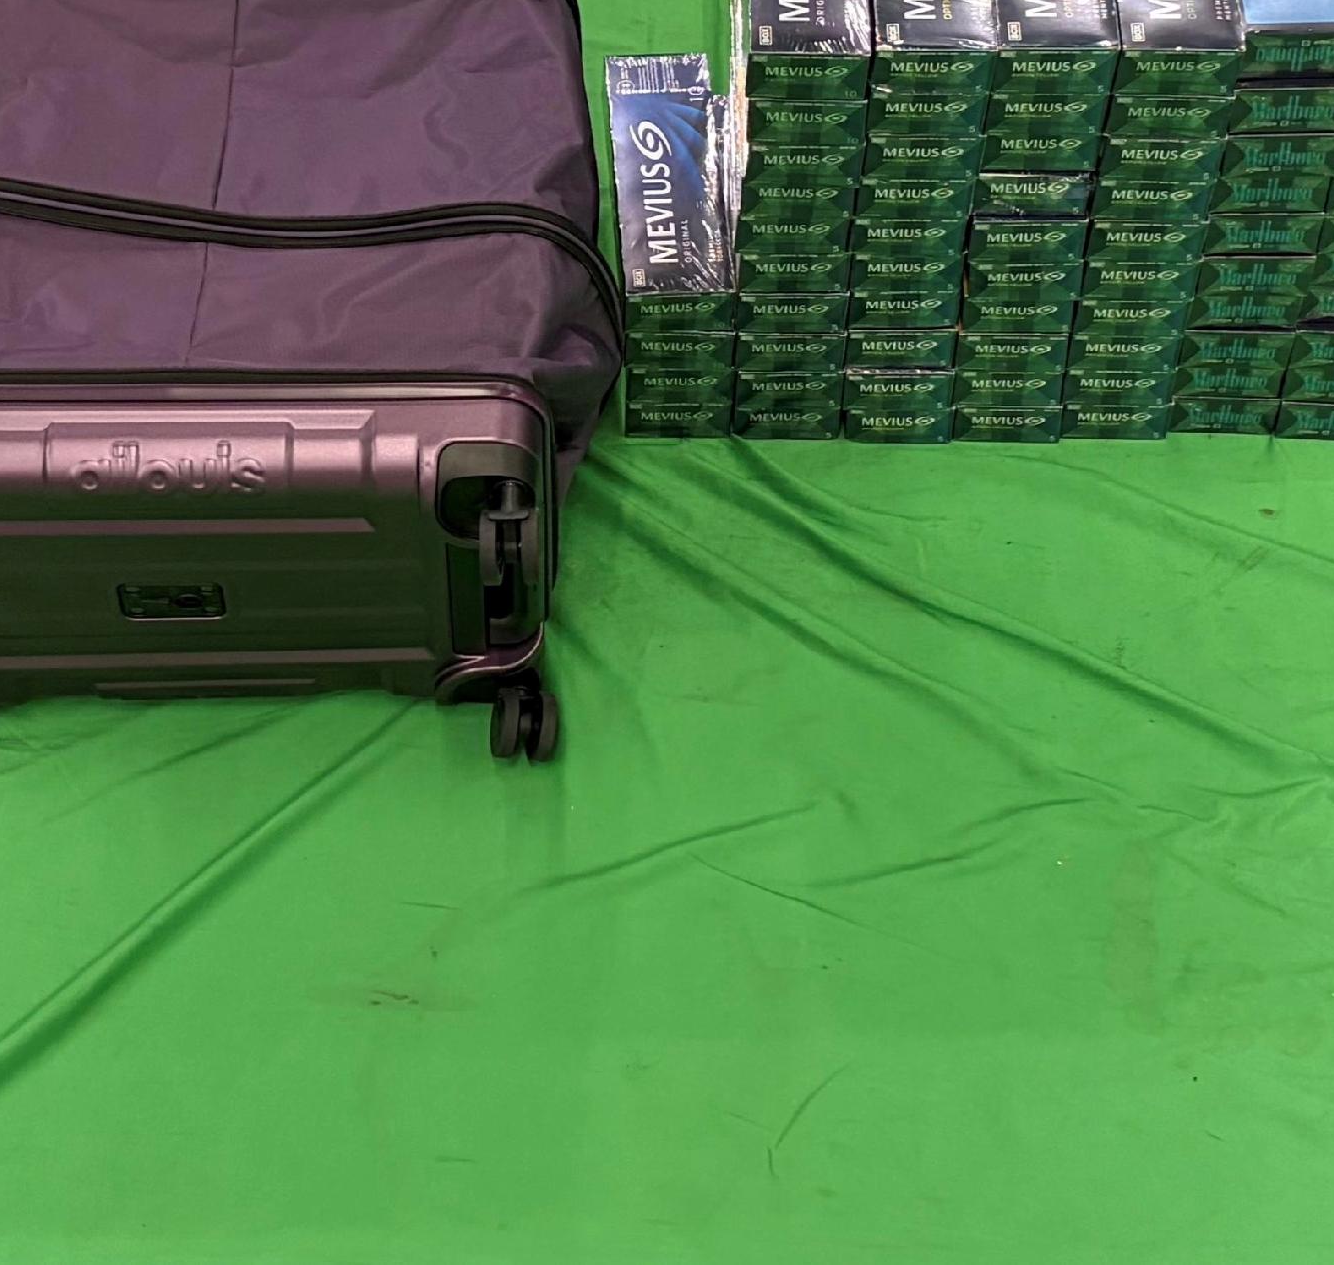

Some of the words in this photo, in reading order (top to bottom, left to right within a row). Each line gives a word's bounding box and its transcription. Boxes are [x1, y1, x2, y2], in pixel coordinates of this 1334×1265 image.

[765, 66, 824, 77] MEVIUS
[891, 62, 949, 73] MEVIUS
[1013, 61, 1073, 72] MEVIUS
[1137, 61, 1195, 72] MEVIUS
[885, 102, 944, 113] MEVIUS
[1005, 102, 1063, 113] MEVIUS
[1128, 107, 1187, 118] MEVIUS
[765, 113, 823, 124] MEVIUS
[1000, 139, 1058, 149] MEVIUS
[883, 147, 939, 158] MEVIUS
[1121, 150, 1179, 161] MEVIUS
[764, 154, 821, 165] MEVIUS
[991, 182, 1046, 194] MEVIUS
[1112, 190, 1169, 201] MEVIUS
[640, 163, 678, 264] MEVIUS
[868, 228, 921, 238] MEVIUS
[987, 232, 1043, 243] MEVIUS
[1106, 232, 1163, 243] MEVIUS
[681, 219, 692, 263] ORIGINAL
[755, 262, 809, 273] MEVIUS
[868, 263, 921, 273] MEVIUS
[641, 302, 693, 314] MEVIUS
[753, 304, 807, 315] MEVIUS
[1094, 309, 1147, 318] MEVIUS
[641, 340, 694, 352] MEVIUS
[862, 340, 915, 351] MEVIUS
[976, 344, 1029, 354] MEVIUS
[862, 416, 914, 426] MEVIUS
[972, 416, 1024, 426] MEVIUS
[1078, 412, 1129, 422] MEVIUS
